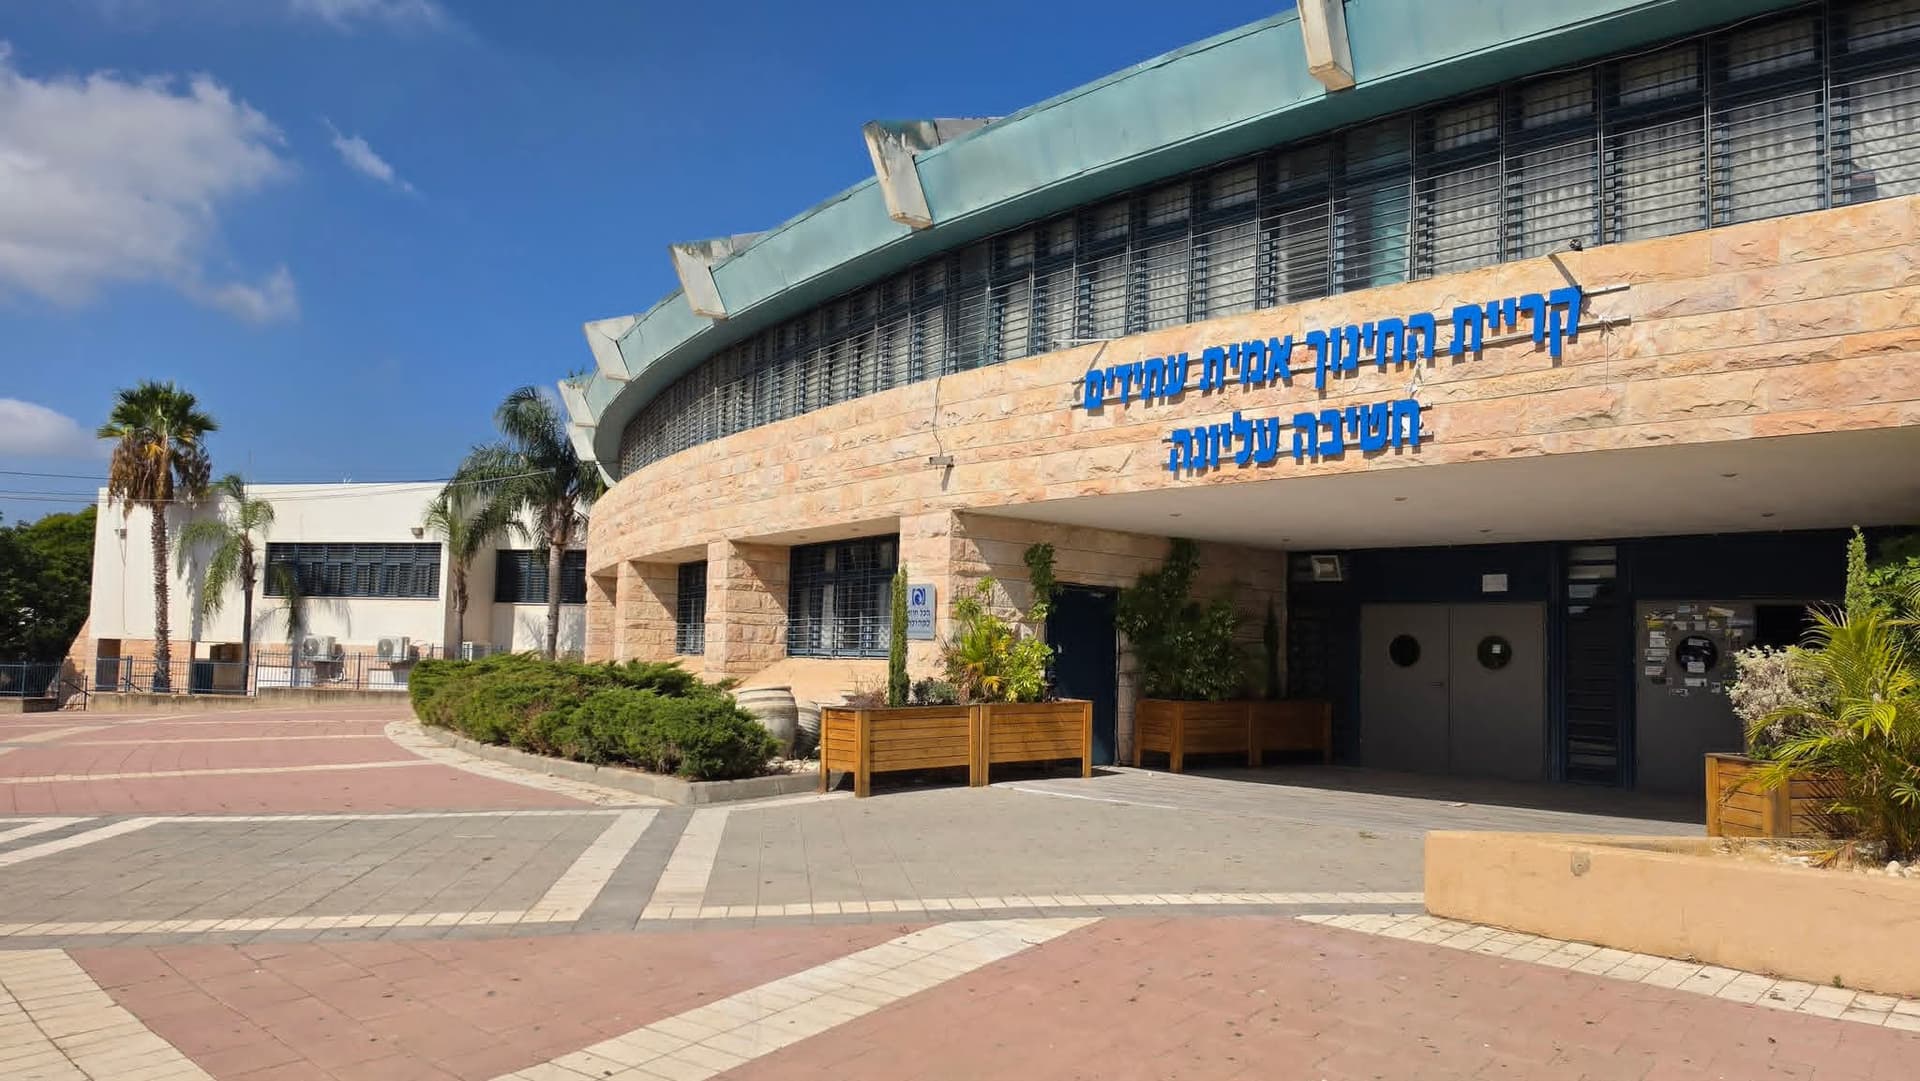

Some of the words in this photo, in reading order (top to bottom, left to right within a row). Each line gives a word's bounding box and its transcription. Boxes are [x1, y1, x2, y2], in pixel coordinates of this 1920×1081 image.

[1306, 311, 1435, 389] החינוך
[1450, 286, 1583, 357] קריית
[1084, 352, 1189, 410] עתידים
[1199, 335, 1293, 391] אמית
[1168, 411, 1280, 472] עליונה
[1292, 399, 1420, 459] חטיבה
